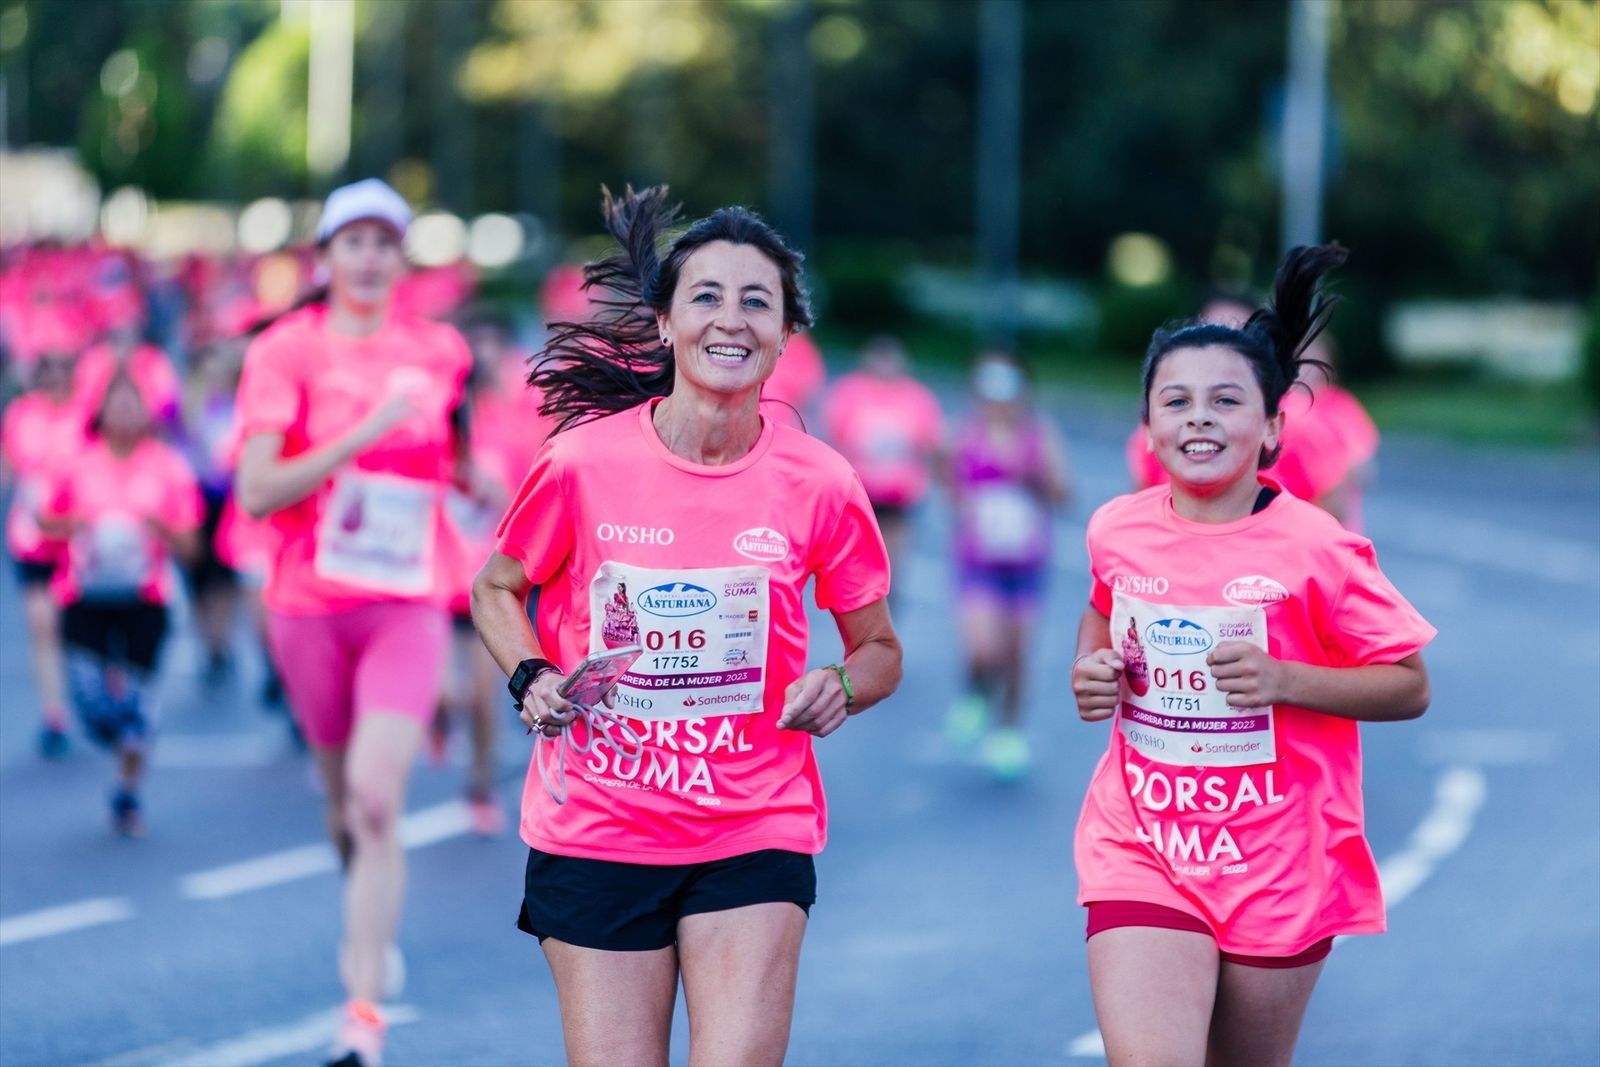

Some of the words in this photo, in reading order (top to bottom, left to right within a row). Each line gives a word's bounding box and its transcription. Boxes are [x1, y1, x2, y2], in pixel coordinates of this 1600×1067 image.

[597, 522, 675, 546] OYSHO
[740, 535, 786, 554] ASTURIANA
[724, 587, 757, 597] SUMA
[1114, 575, 1169, 595] OYSHO
[643, 594, 710, 609] ASTURIANA
[646, 629, 706, 651] 016
[1150, 629, 1207, 647] ASTURIANA
[1219, 628, 1253, 637] SUMA
[652, 655, 699, 669] 17752
[621, 674, 653, 687] RRERA
[655, 678, 669, 687] DE
[671, 677, 685, 686] LA
[686, 675, 722, 685] MUJER
[725, 672, 748, 682] 2023
[1154, 667, 1206, 691] 016
[615, 693, 653, 710] YSHO
[698, 692, 751, 706] Santander
[1161, 695, 1200, 711] 17751
[1132, 710, 1163, 726] CARRERA
[1164, 719, 1176, 729] DE
[1177, 720, 1190, 729] LA
[1191, 721, 1228, 730] MUJER
[1230, 720, 1255, 729] 2023
[1130, 729, 1165, 750] OYSHO
[1205, 741, 1261, 753] Santander
[587, 737, 716, 794] SUMA
